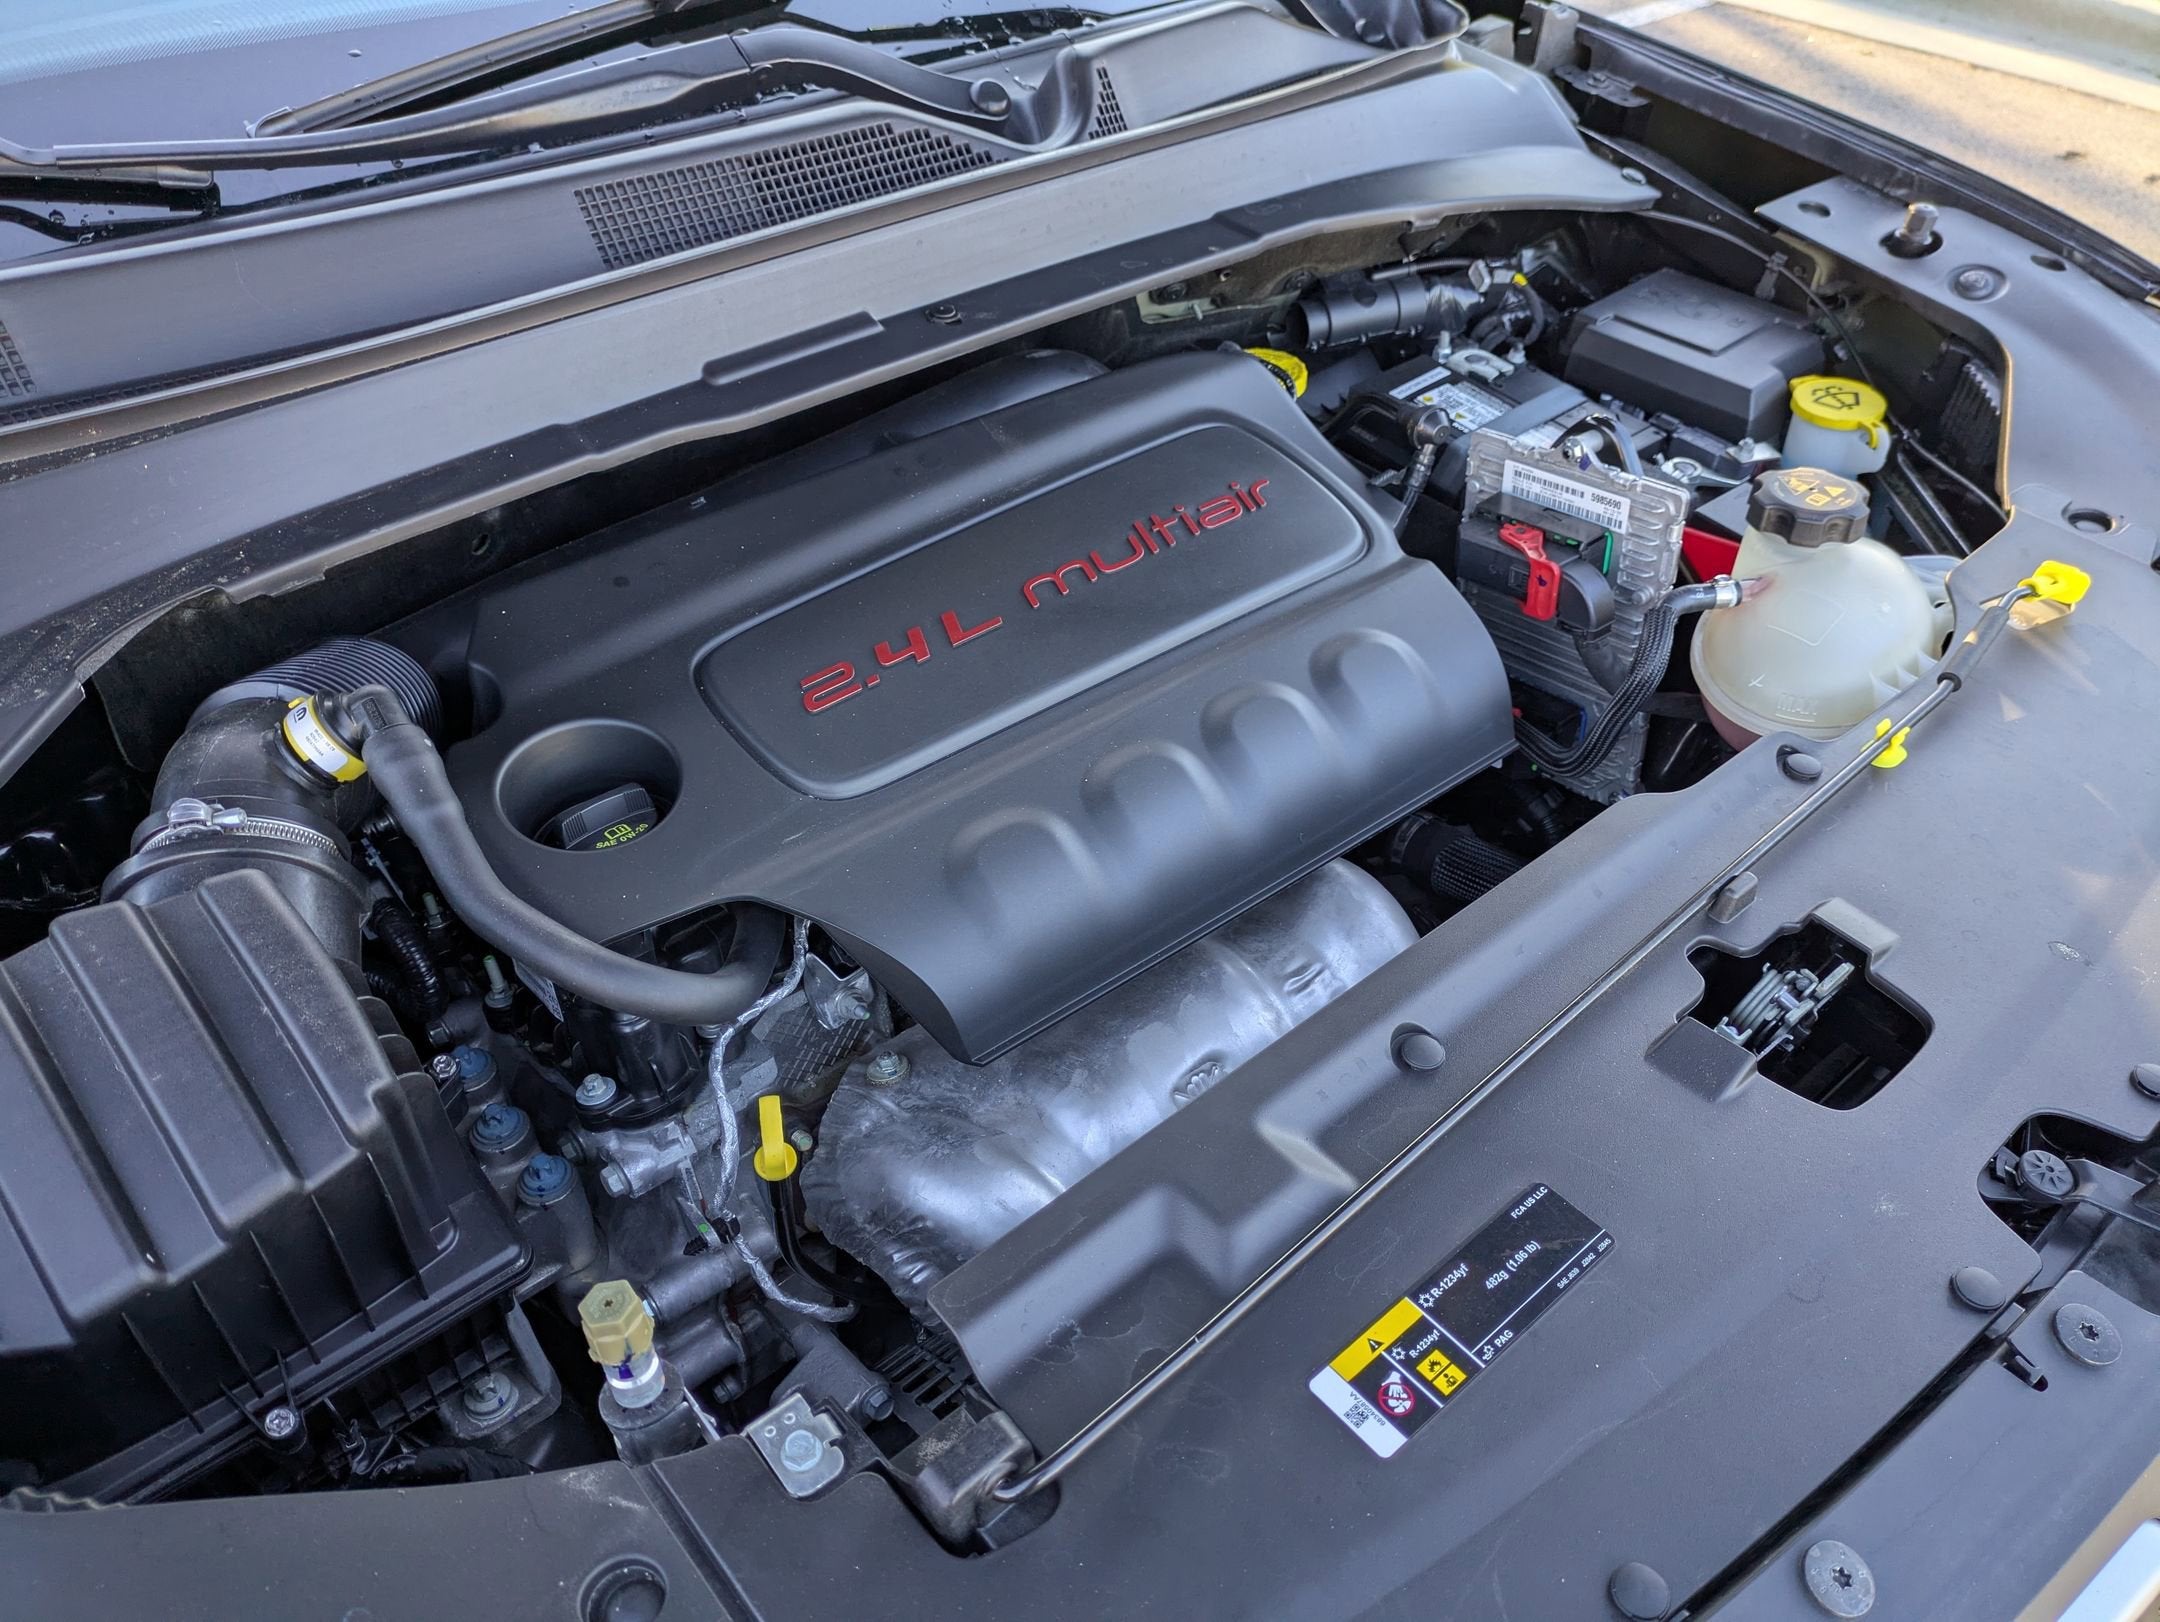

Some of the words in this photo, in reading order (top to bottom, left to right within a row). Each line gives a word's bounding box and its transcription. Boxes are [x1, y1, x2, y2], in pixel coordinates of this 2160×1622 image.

[1023, 479, 1270, 608] multiair
[595, 838, 617, 849] SAE
[620, 823, 649, 842] 0W-20
[1510, 1205, 1527, 1219] FCA
[1523, 1196, 1536, 1207] US
[1532, 1186, 1548, 1199] LLC
[1430, 1263, 1469, 1298] R-1234yf
[1485, 1270, 1509, 1291] 482g
[1505, 1249, 1529, 1273] (1.06
[1525, 1240, 1541, 1257] lb)
[1556, 1277, 1569, 1289] SAE
[1409, 1329, 1440, 1359] R-1234yf
[1494, 1329, 1514, 1348] PAG
